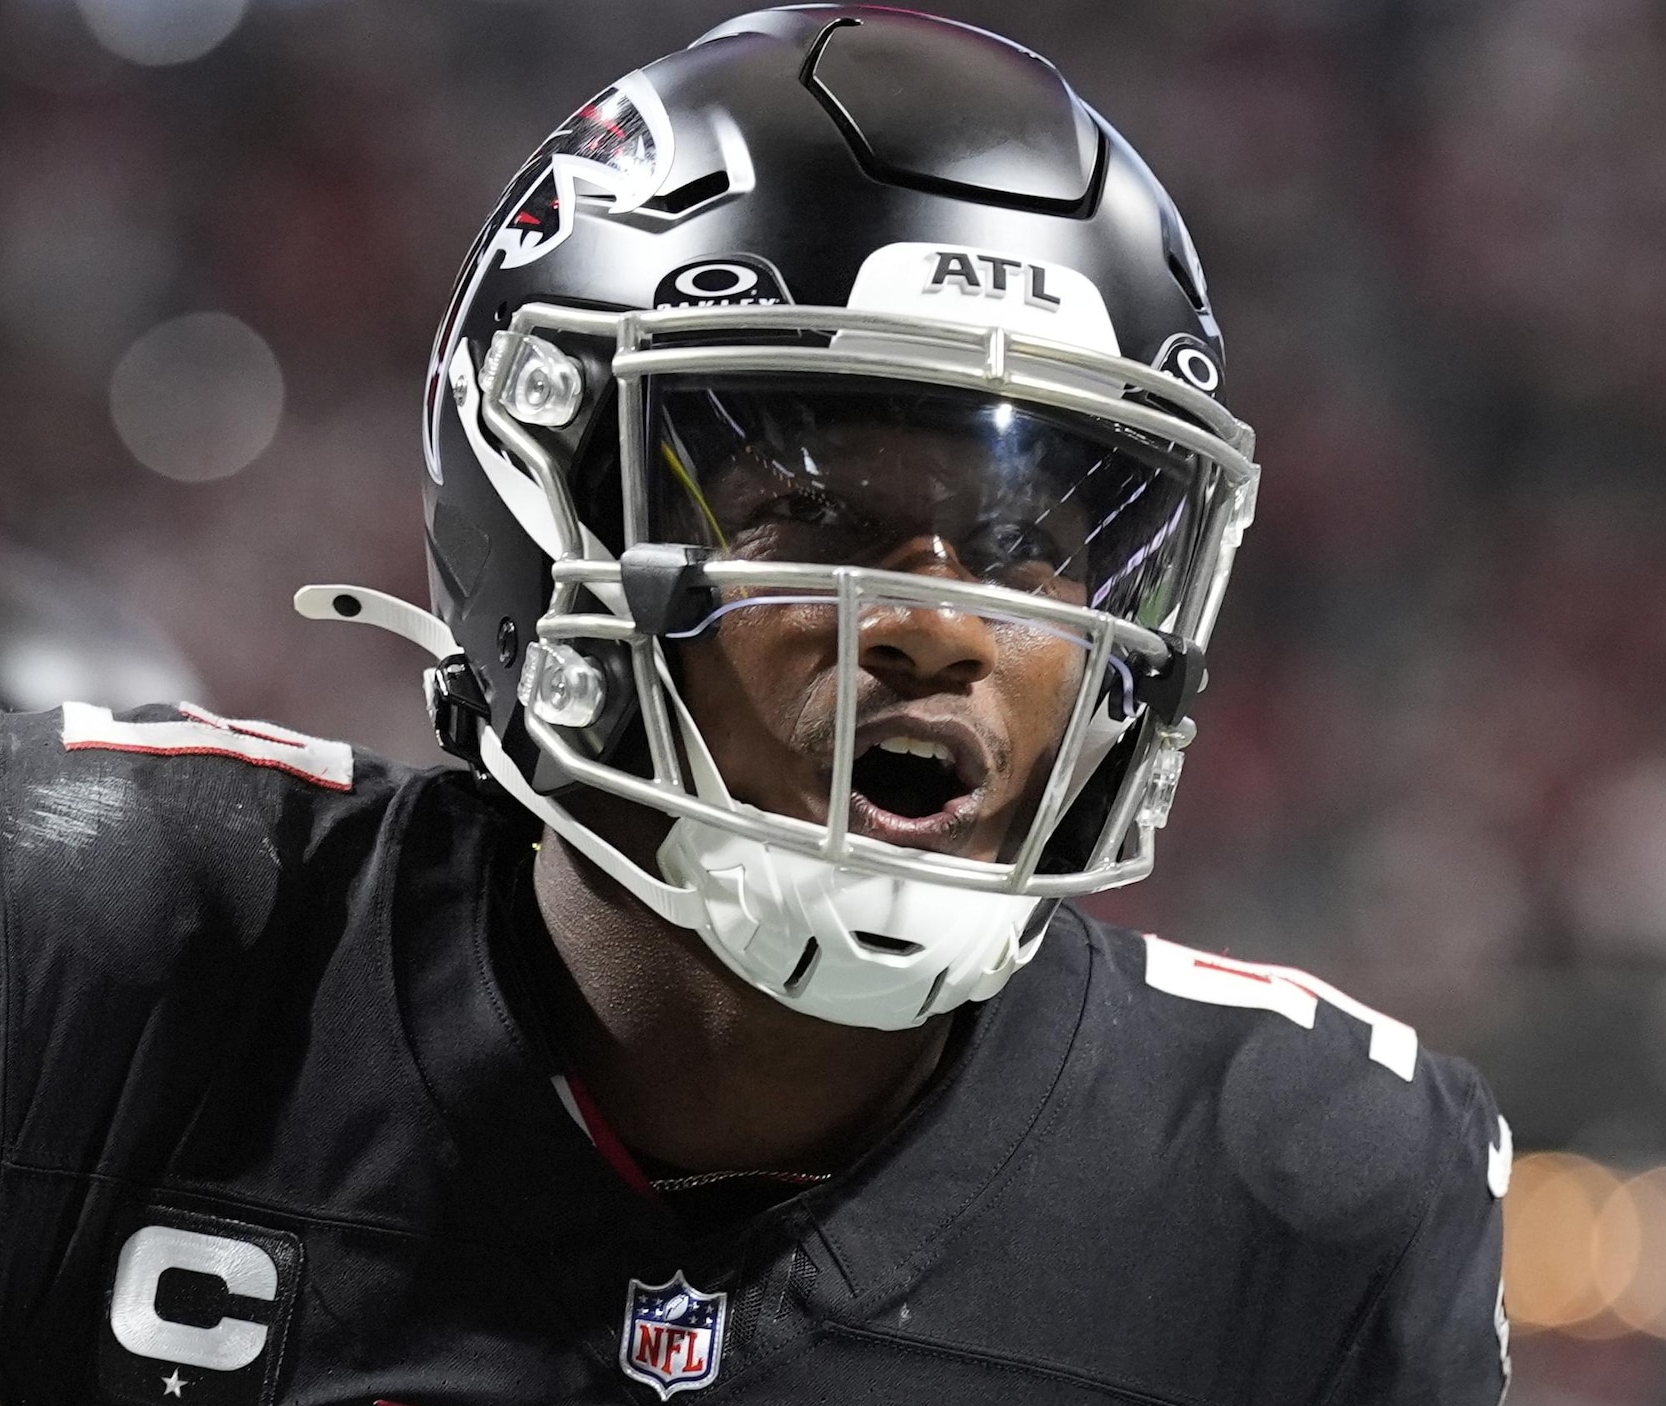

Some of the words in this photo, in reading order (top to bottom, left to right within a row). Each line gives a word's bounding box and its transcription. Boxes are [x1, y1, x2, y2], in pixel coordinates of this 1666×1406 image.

[927, 251, 1061, 308] ATL
[110, 1225, 278, 1372] C
[635, 1324, 705, 1376] NFL
